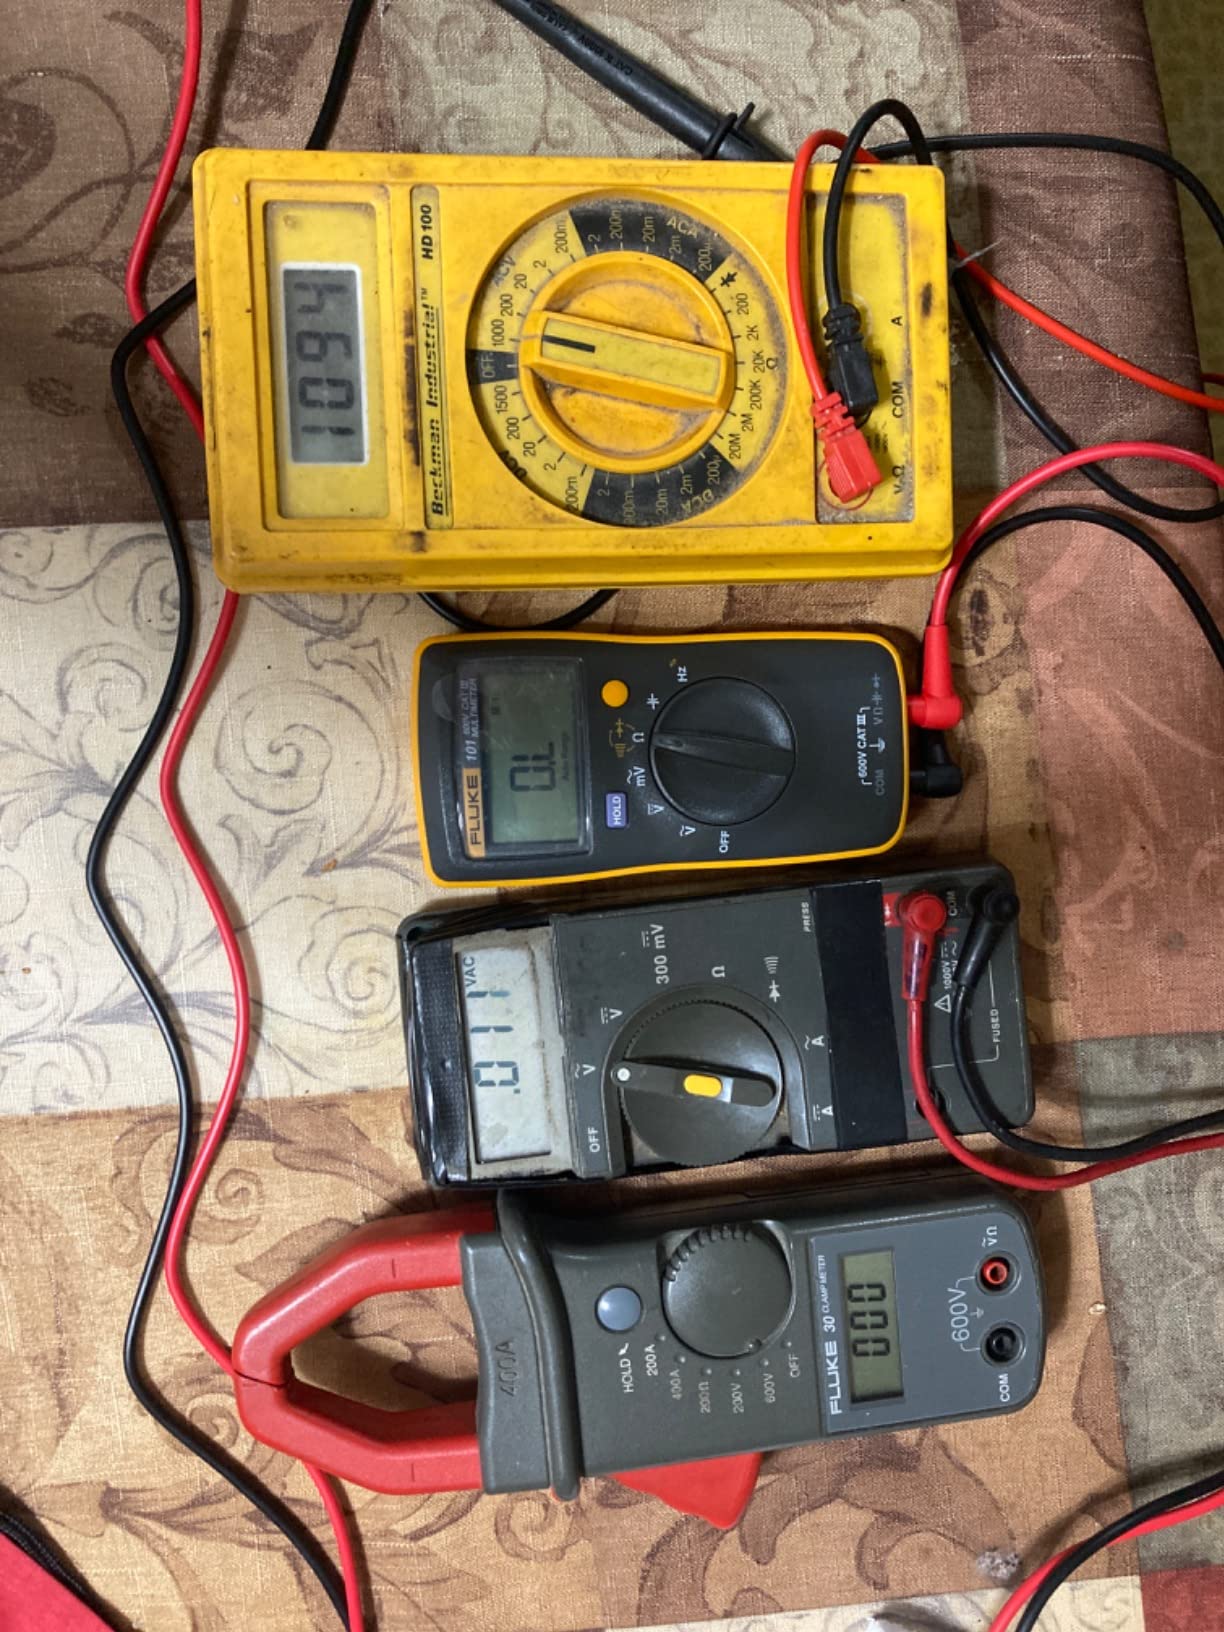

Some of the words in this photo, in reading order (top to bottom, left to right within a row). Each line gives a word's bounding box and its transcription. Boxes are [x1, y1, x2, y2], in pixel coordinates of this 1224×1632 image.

[420, 204, 432, 231] 100
[643, 216, 655, 242] 20m
[422, 234, 434, 260] HD
[588, 234, 600, 242] 2
[670, 235, 682, 254] 2m
[533, 260, 546, 268] 2
[514, 273, 527, 289] 20
[500, 293, 514, 316] 200
[736, 292, 749, 315] 200
[491, 318, 504, 346] 1000
[748, 324, 758, 340] 2K
[891, 315, 902, 326] A
[294, 282, 355, 436] 1094
[482, 354, 495, 378] OFF
[753, 349, 766, 373] 20K
[494, 384, 508, 414] 1500
[750, 378, 762, 410] 200K
[892, 381, 904, 418] COM
[506, 416, 520, 440] 200
[742, 412, 754, 432] 2M
[523, 441, 536, 457] 20
[729, 433, 742, 459] 20M
[428, 418, 444, 516] Beckman
[544, 462, 556, 471] 2
[597, 488, 610, 496] 2
[681, 474, 692, 494] 2m
[656, 488, 668, 514] 20m
[676, 665, 688, 682] Hz
[469, 678, 480, 737] MULTIMETER
[466, 739, 477, 761] 101
[632, 732, 644, 742] Ω
[856, 726, 866, 749] CAT
[858, 751, 868, 778] 600V
[874, 768, 886, 796] COM
[466, 774, 482, 845] FLUKE
[612, 795, 622, 825] HOLD
[719, 830, 730, 853] OFF
[947, 890, 958, 916] COM
[802, 901, 812, 932] PRESS
[650, 923, 666, 949] mV
[463, 956, 477, 988] VAC
[653, 954, 670, 984] 300
[712, 964, 726, 978] Ω
[990, 1008, 1000, 1042] FUSED
[588, 1126, 600, 1153] OFF
[818, 1254, 828, 1284] METER
[820, 1284, 830, 1313] CLAMP
[822, 1316, 836, 1332] 30
[848, 1283, 890, 1357] 000
[948, 1287, 970, 1342] 600V
[494, 1338, 518, 1397] 400A
[644, 1343, 658, 1376] 200A
[789, 1352, 800, 1378] OFF
[620, 1358, 634, 1392] HOLD
[670, 1368, 682, 1400] 400A
[763, 1372, 776, 1402] 600V
[824, 1340, 842, 1414] FLUKE
[998, 1372, 1010, 1402] COM
[732, 1382, 744, 1413] 200V
